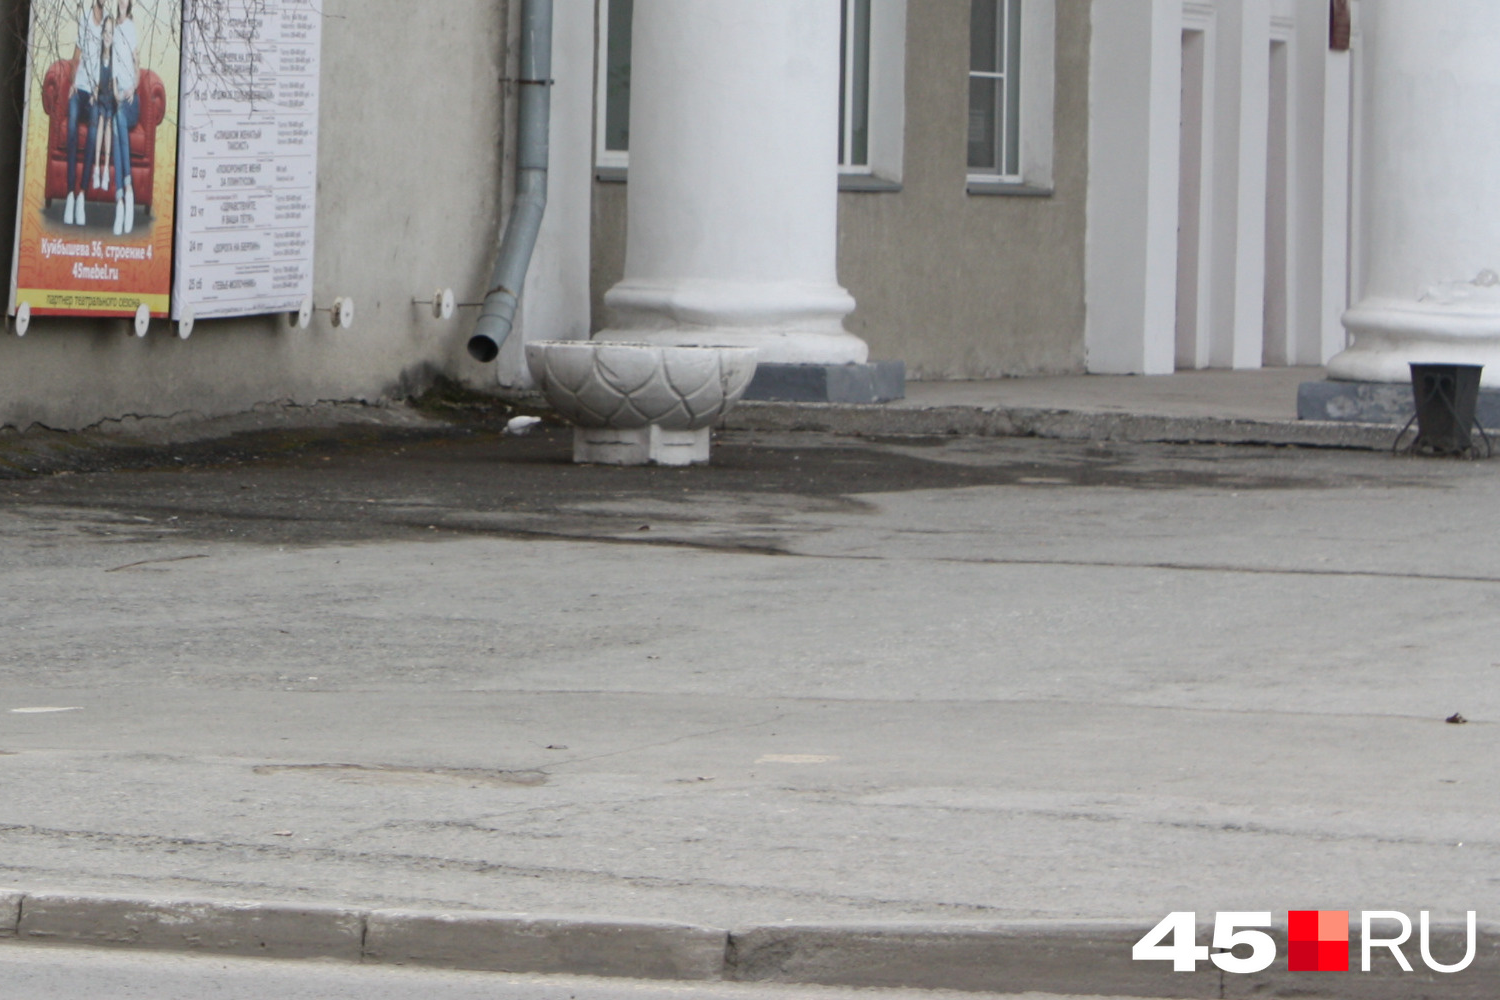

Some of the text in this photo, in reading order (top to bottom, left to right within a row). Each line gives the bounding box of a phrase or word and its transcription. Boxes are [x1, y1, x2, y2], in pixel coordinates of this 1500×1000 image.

[41, 238, 90, 259] Куйбышева
[105, 246, 145, 263] строение
[146, 244, 152, 260] 4
[72, 262, 119, 280] 45mebel.ru
